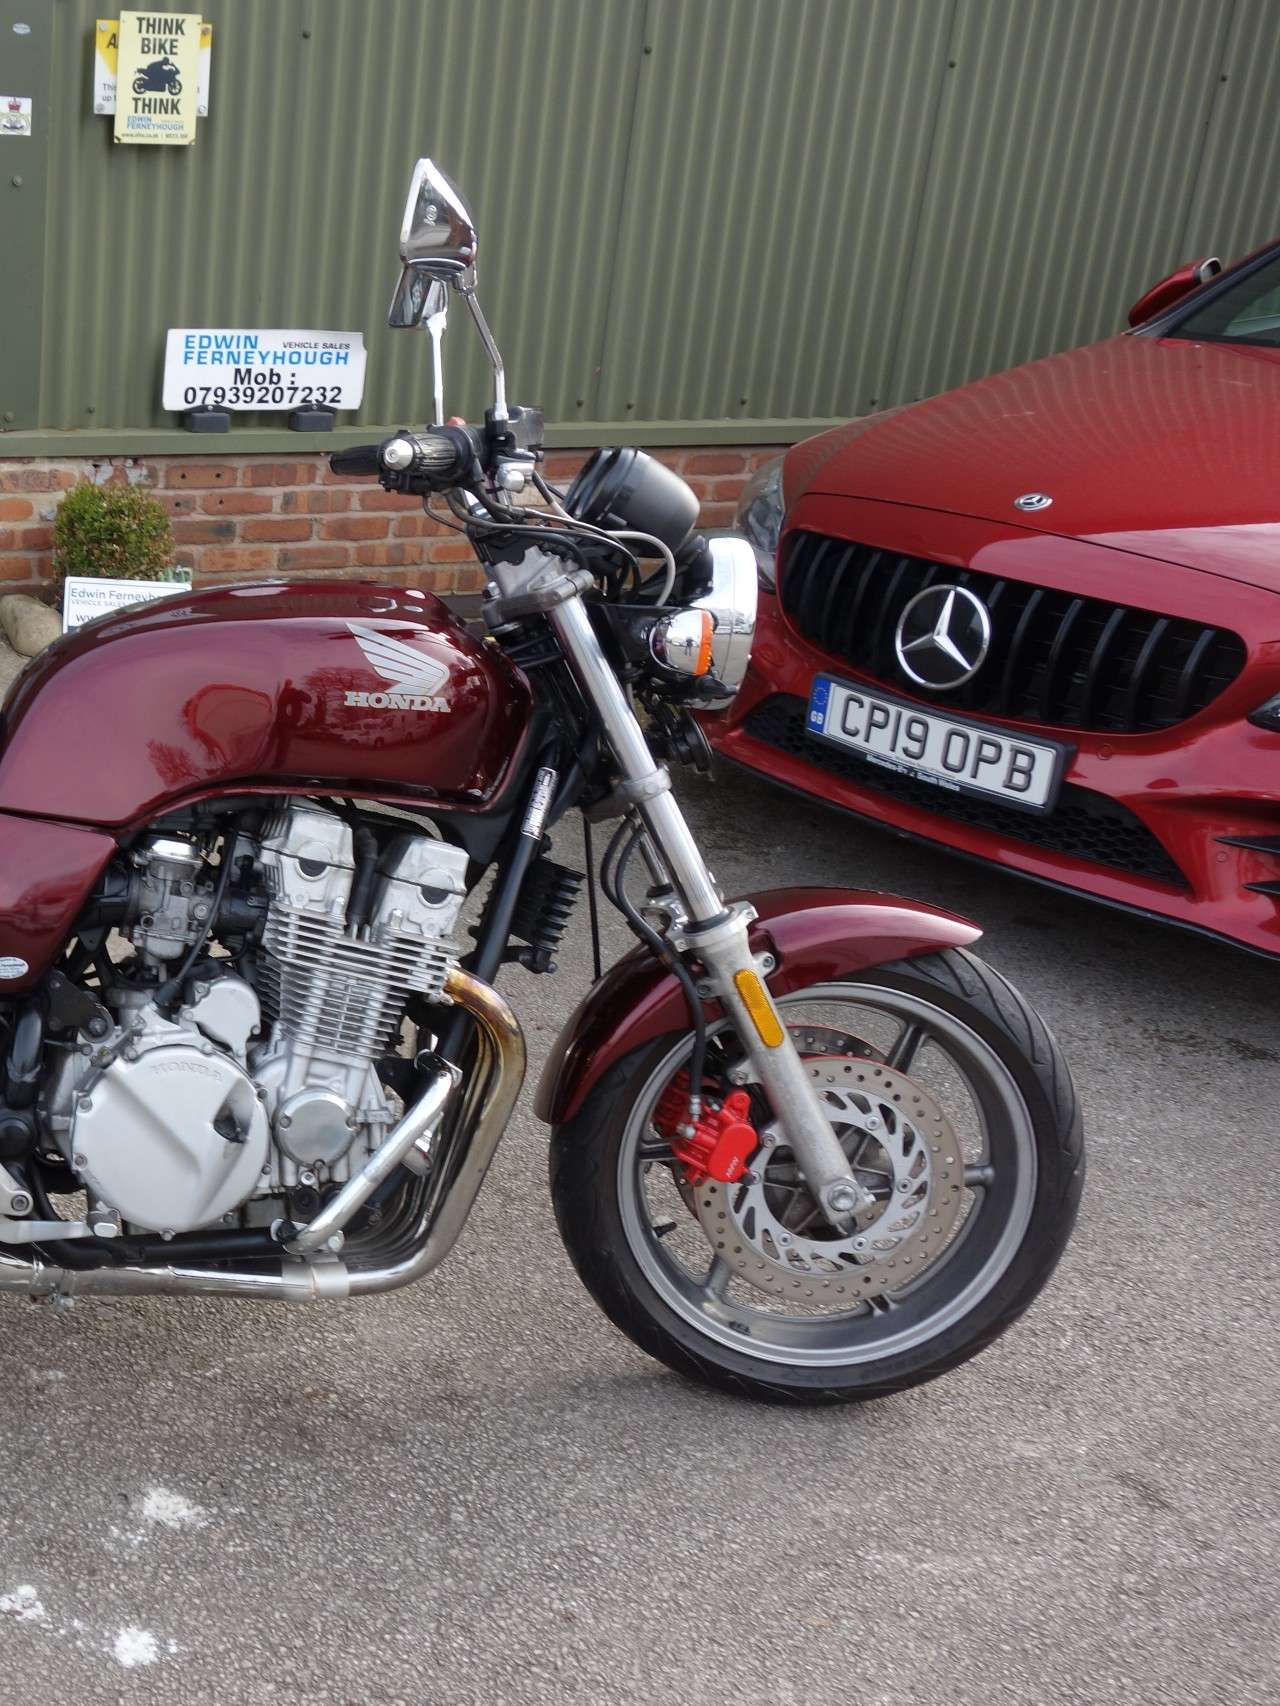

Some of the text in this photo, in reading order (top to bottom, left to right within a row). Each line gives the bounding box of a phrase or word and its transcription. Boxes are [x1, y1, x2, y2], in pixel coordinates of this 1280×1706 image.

[136, 16, 186, 36] THINK
[141, 37, 179, 55] BIKE
[132, 97, 181, 115] THINK
[184, 335, 259, 350] EDWIN
[282, 341, 351, 350] VEHICLE SALES
[183, 350, 350, 366] FERNEYHOUGH
[184, 386, 342, 405] 07939207232
[71, 588, 106, 599] Edwin
[344, 691, 452, 713] HONDA
[810, 693, 1036, 792] GB CP19 OPB
